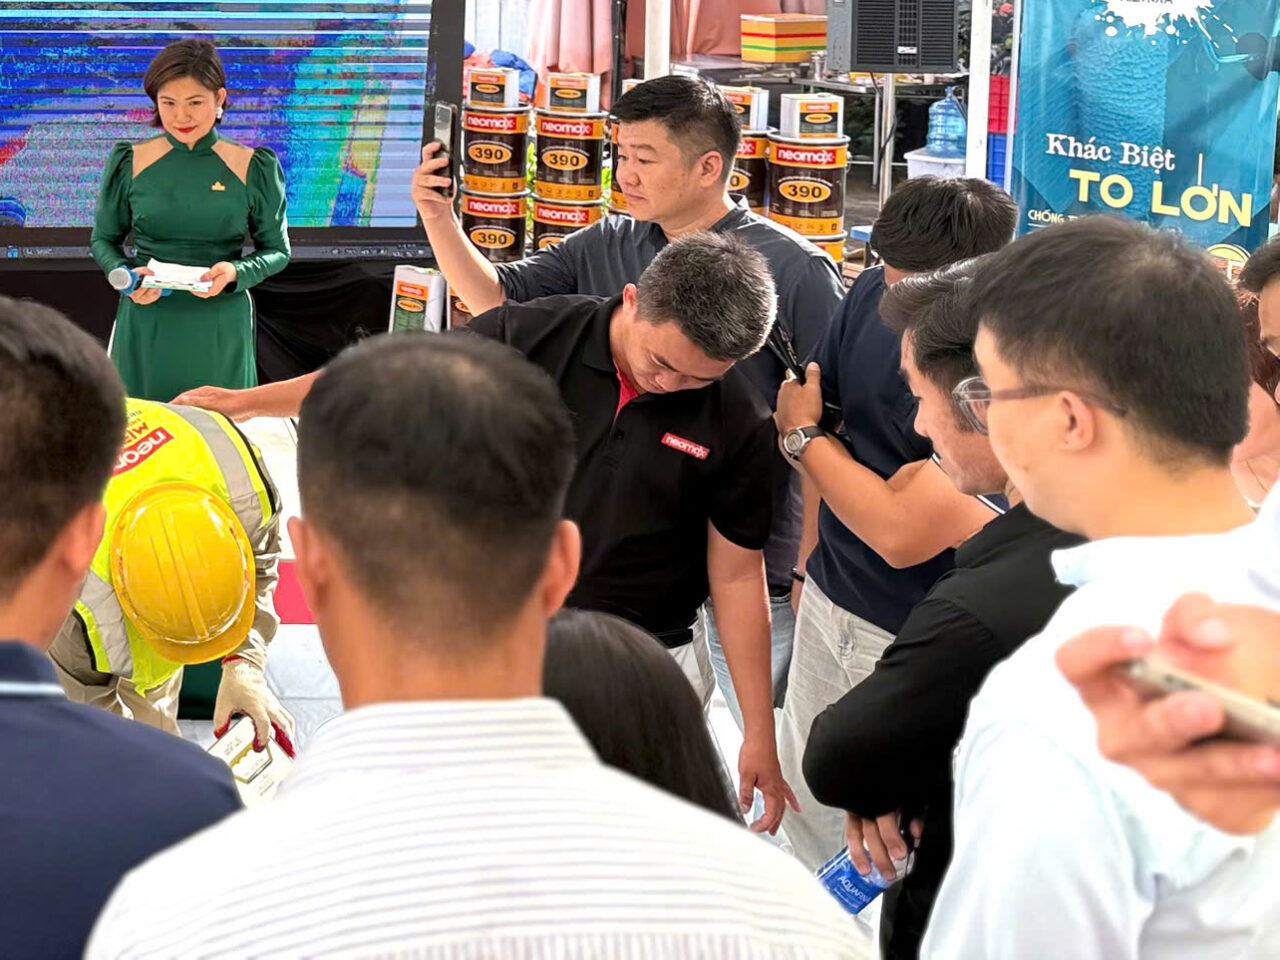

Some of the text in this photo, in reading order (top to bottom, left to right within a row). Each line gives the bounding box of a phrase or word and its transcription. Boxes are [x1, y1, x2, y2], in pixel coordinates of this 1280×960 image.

[467, 115, 515, 130] neomax
[541, 121, 591, 136] neomax
[474, 147, 504, 161] 390
[549, 153, 580, 167] 390
[777, 148, 834, 165] neomax
[1045, 132, 1176, 175] Khác Biệt
[787, 184, 822, 199] 390
[1069, 168, 1134, 209] TO
[469, 200, 517, 215] neomax
[537, 207, 588, 223] neomax
[477, 232, 508, 245] 390
[665, 436, 707, 458] neomax
